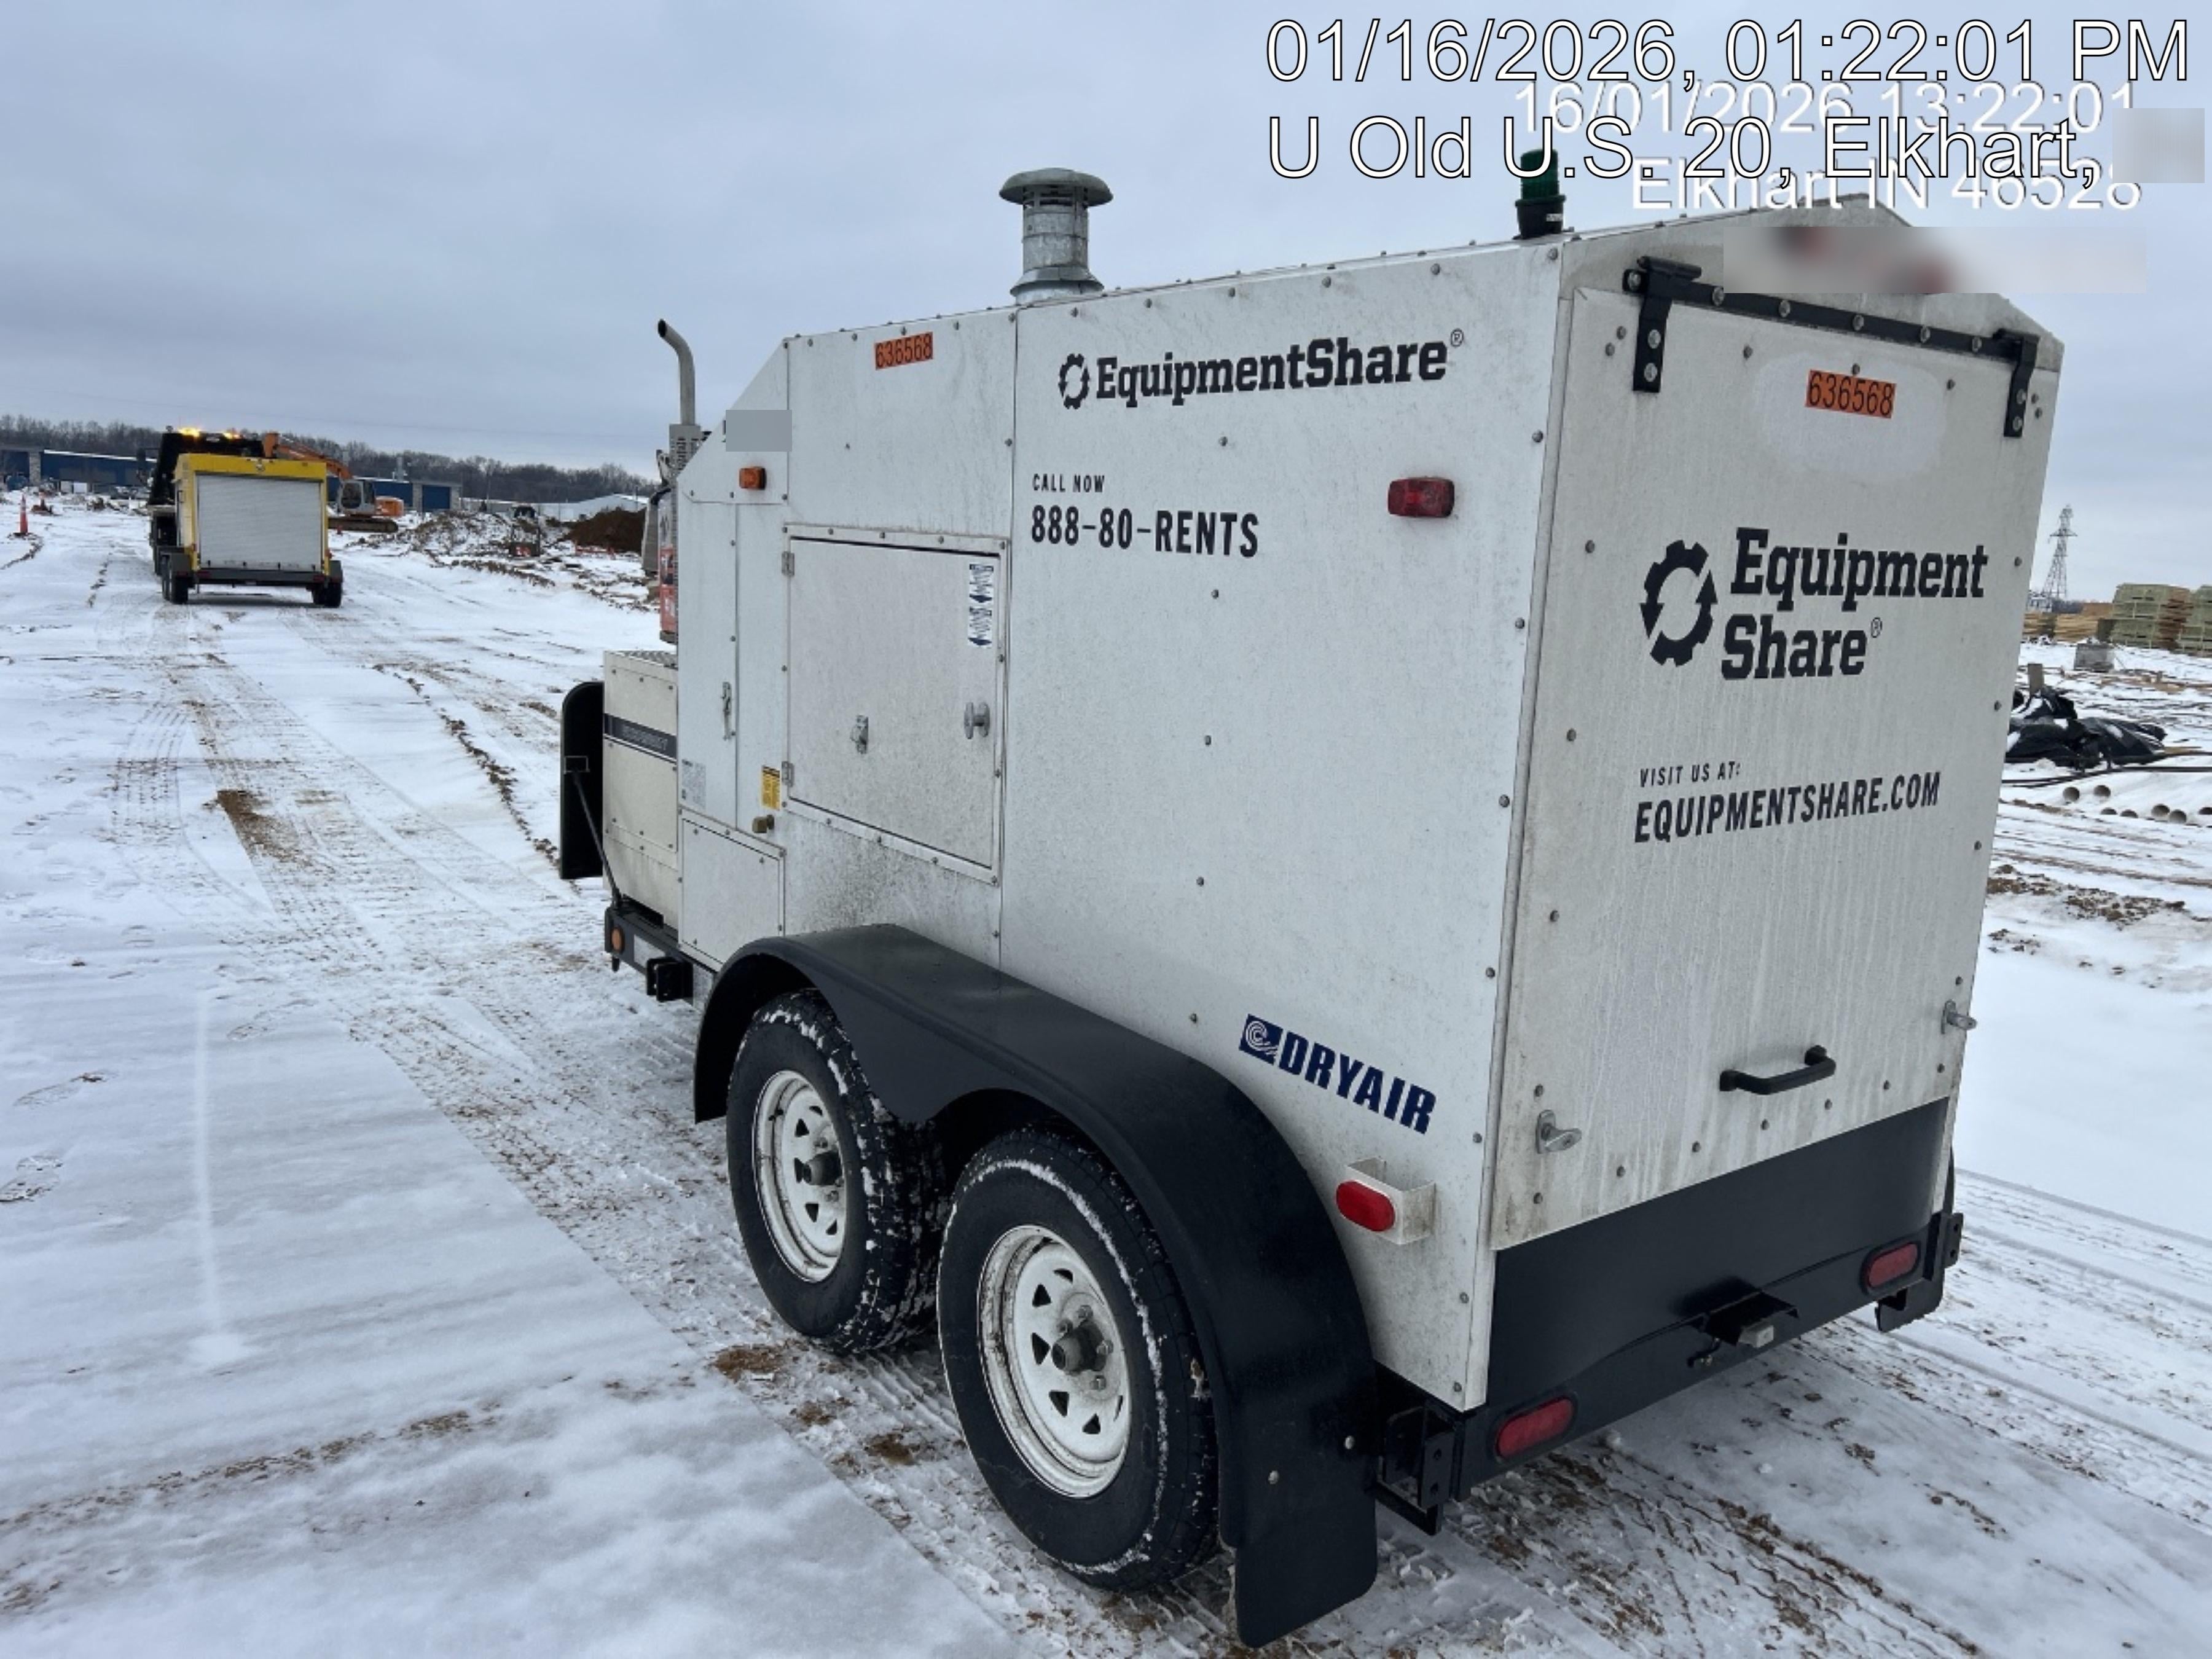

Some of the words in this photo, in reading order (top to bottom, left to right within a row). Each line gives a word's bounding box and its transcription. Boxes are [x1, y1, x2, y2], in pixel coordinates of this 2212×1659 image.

[876, 333, 932, 368] 636568
[1809, 372, 1893, 415] 636568
[1032, 473, 1066, 492] CALL
[1072, 475, 1105, 492] NOW
[1032, 504, 1259, 558] 888-80-RENTS
[1730, 527, 1988, 612] Equipment
[1640, 766, 1683, 787] VISIT
[1691, 763, 1710, 782] US
[1717, 761, 1741, 780] AT:
[1634, 772, 1941, 842] EQUIPMENTSHARE.COM
[1279, 1031, 1437, 1134] DRYAIR
